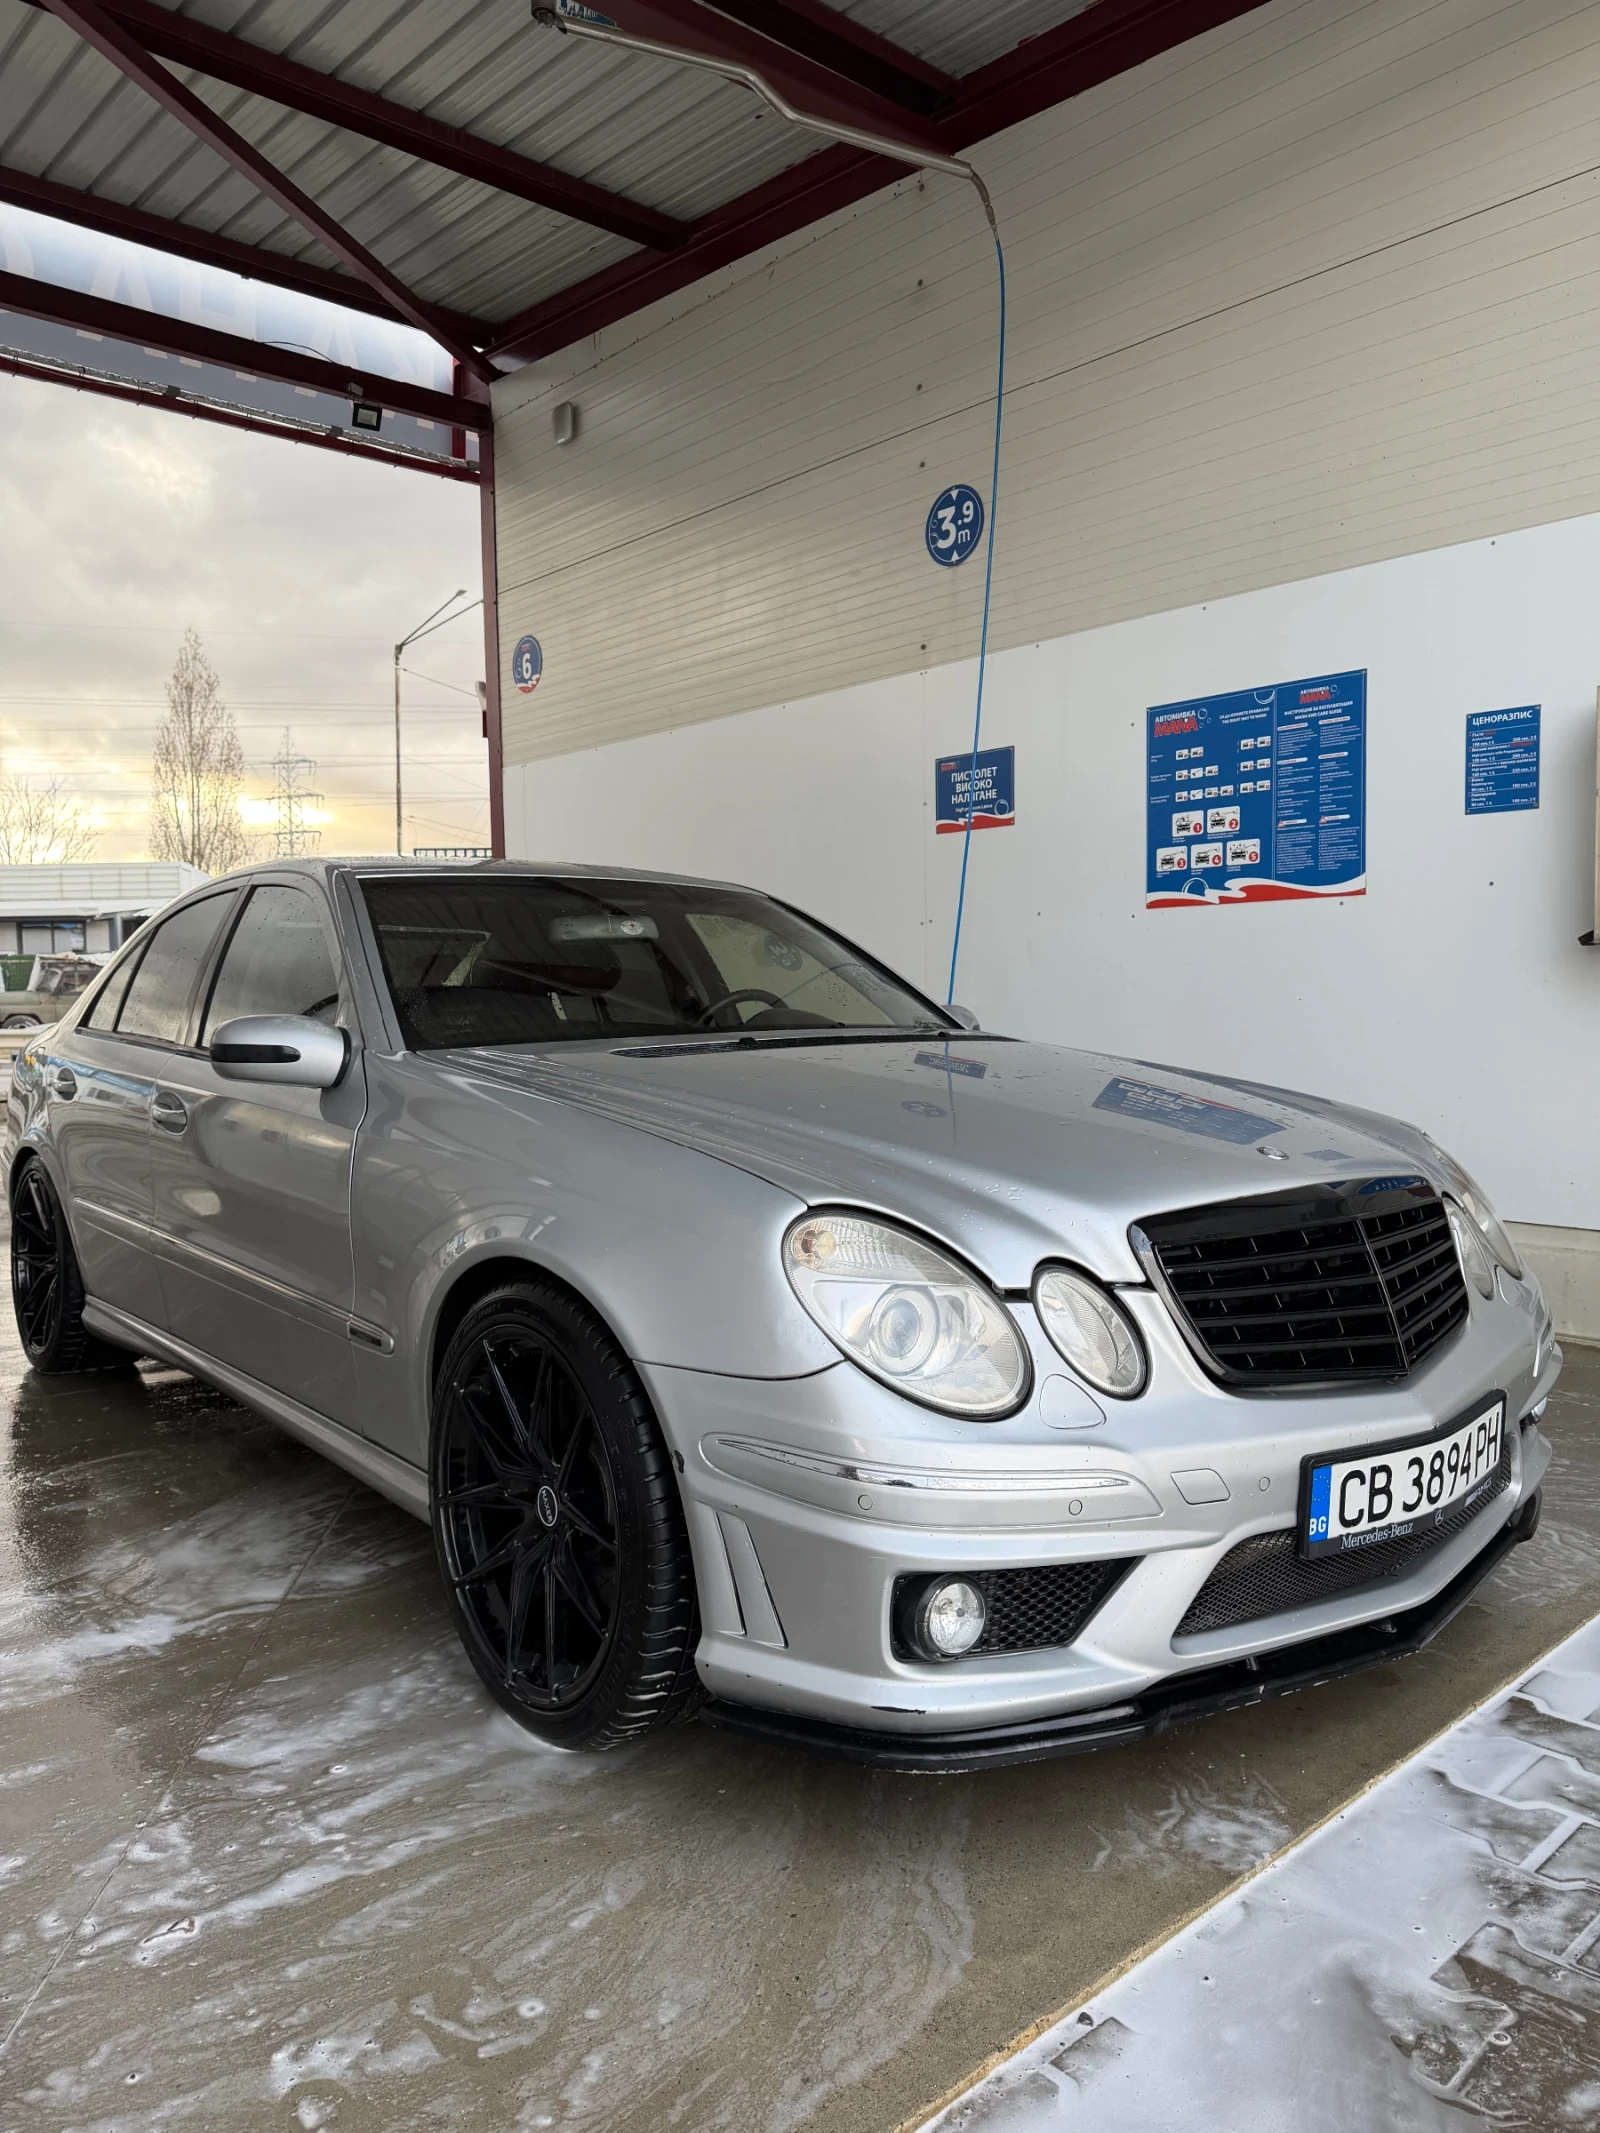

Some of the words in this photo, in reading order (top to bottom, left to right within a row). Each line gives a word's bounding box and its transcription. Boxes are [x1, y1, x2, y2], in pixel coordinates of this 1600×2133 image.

[522, 652, 532, 680] 6
[1155, 709, 1196, 723] АВТОМИВКА
[1472, 710, 1533, 726] ЦЕНОРАЗПИС
[1154, 717, 1198, 738] MANA
[955, 778, 993, 793] ВИСОКО
[1402, 1431, 1472, 1513] 3894
[1474, 1411, 1500, 1477] PH
[1309, 1516, 1327, 1536] BG
[1340, 1522, 1414, 1550] Mercedes-Benz
